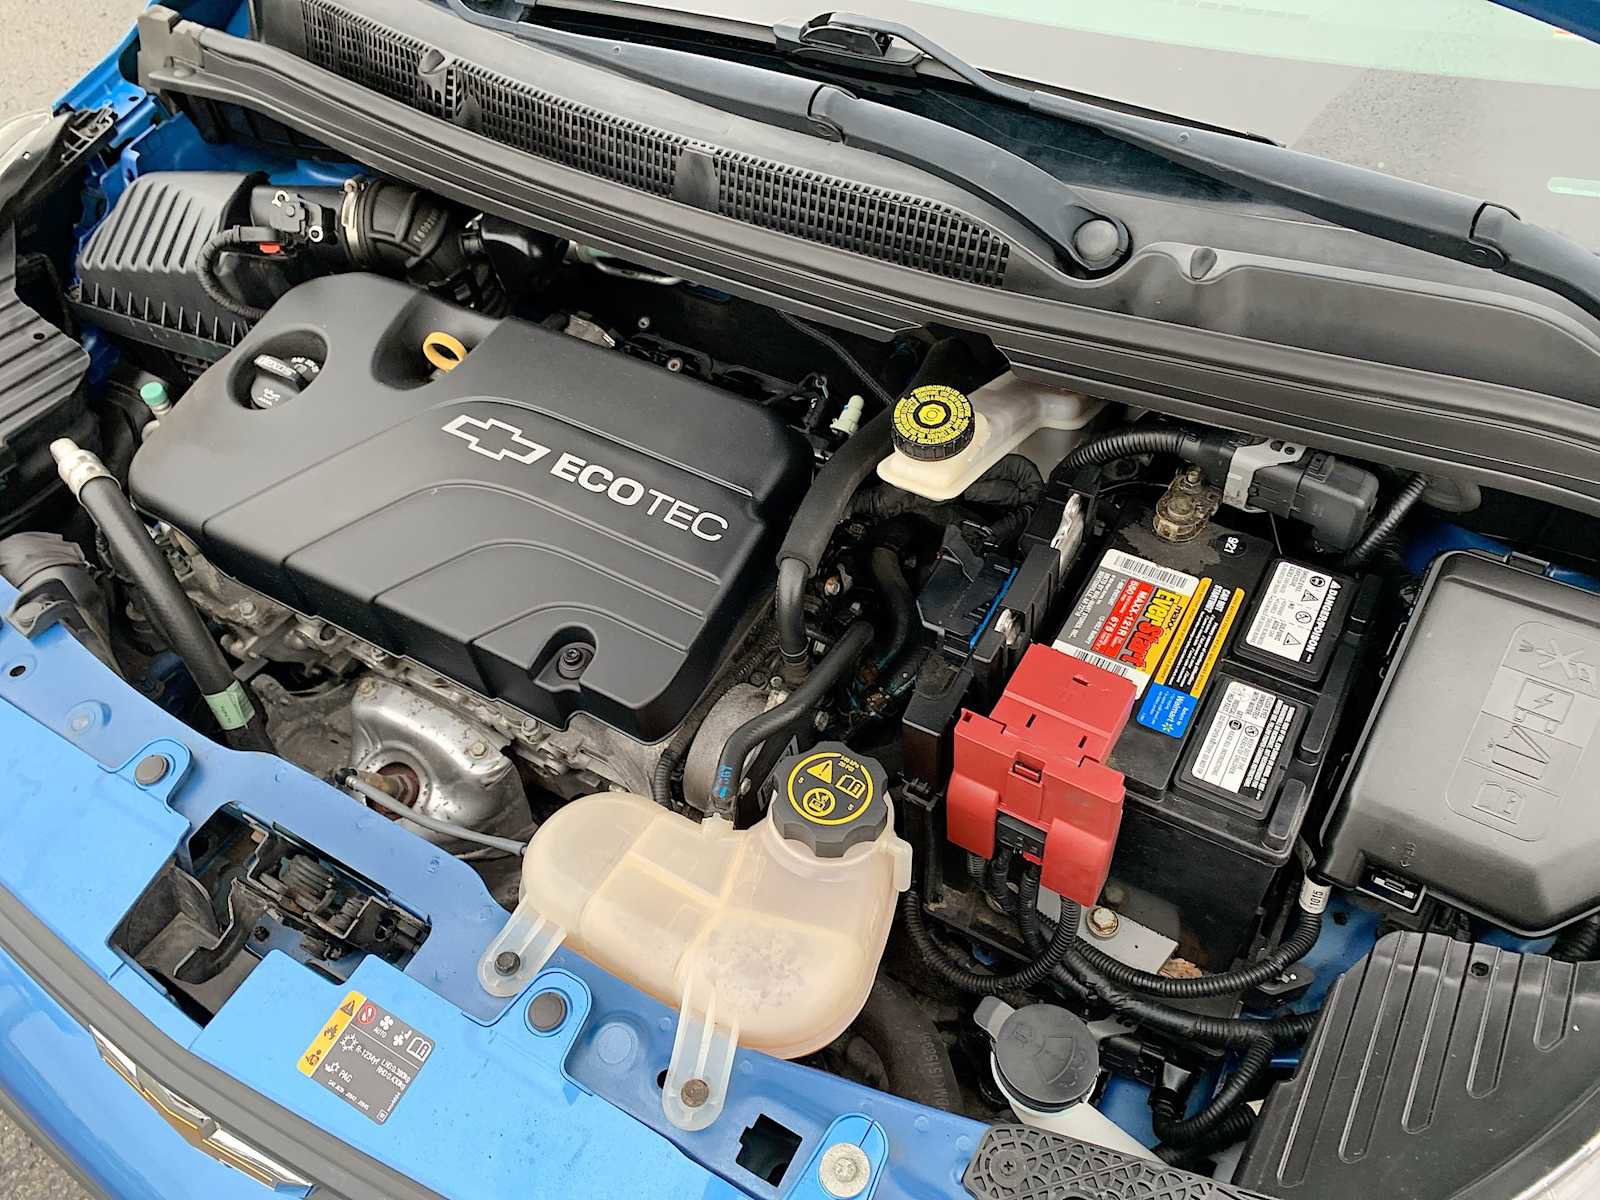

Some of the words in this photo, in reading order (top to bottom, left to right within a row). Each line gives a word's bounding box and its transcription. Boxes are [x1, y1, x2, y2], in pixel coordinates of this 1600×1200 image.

[256, 353, 294, 376] dexos
[550, 452, 729, 542] ECOTEC
[1203, 584, 1223, 613] STARTING?
[1213, 599, 1225, 612] NOT
[1219, 588, 1231, 601] CAR
[1116, 589, 1148, 637] MAXX-121R
[1166, 605, 1182, 630] maxx
[1303, 588, 1339, 654] DANGER/POISON
[1119, 587, 1182, 671] EverStart
[1166, 694, 1185, 722] Walmart
[1310, 890, 1324, 906] 1015
[372, 1025, 387, 1038] AUTO
[353, 1044, 380, 1066] R-1234yf
[337, 1068, 354, 1084] PAG
